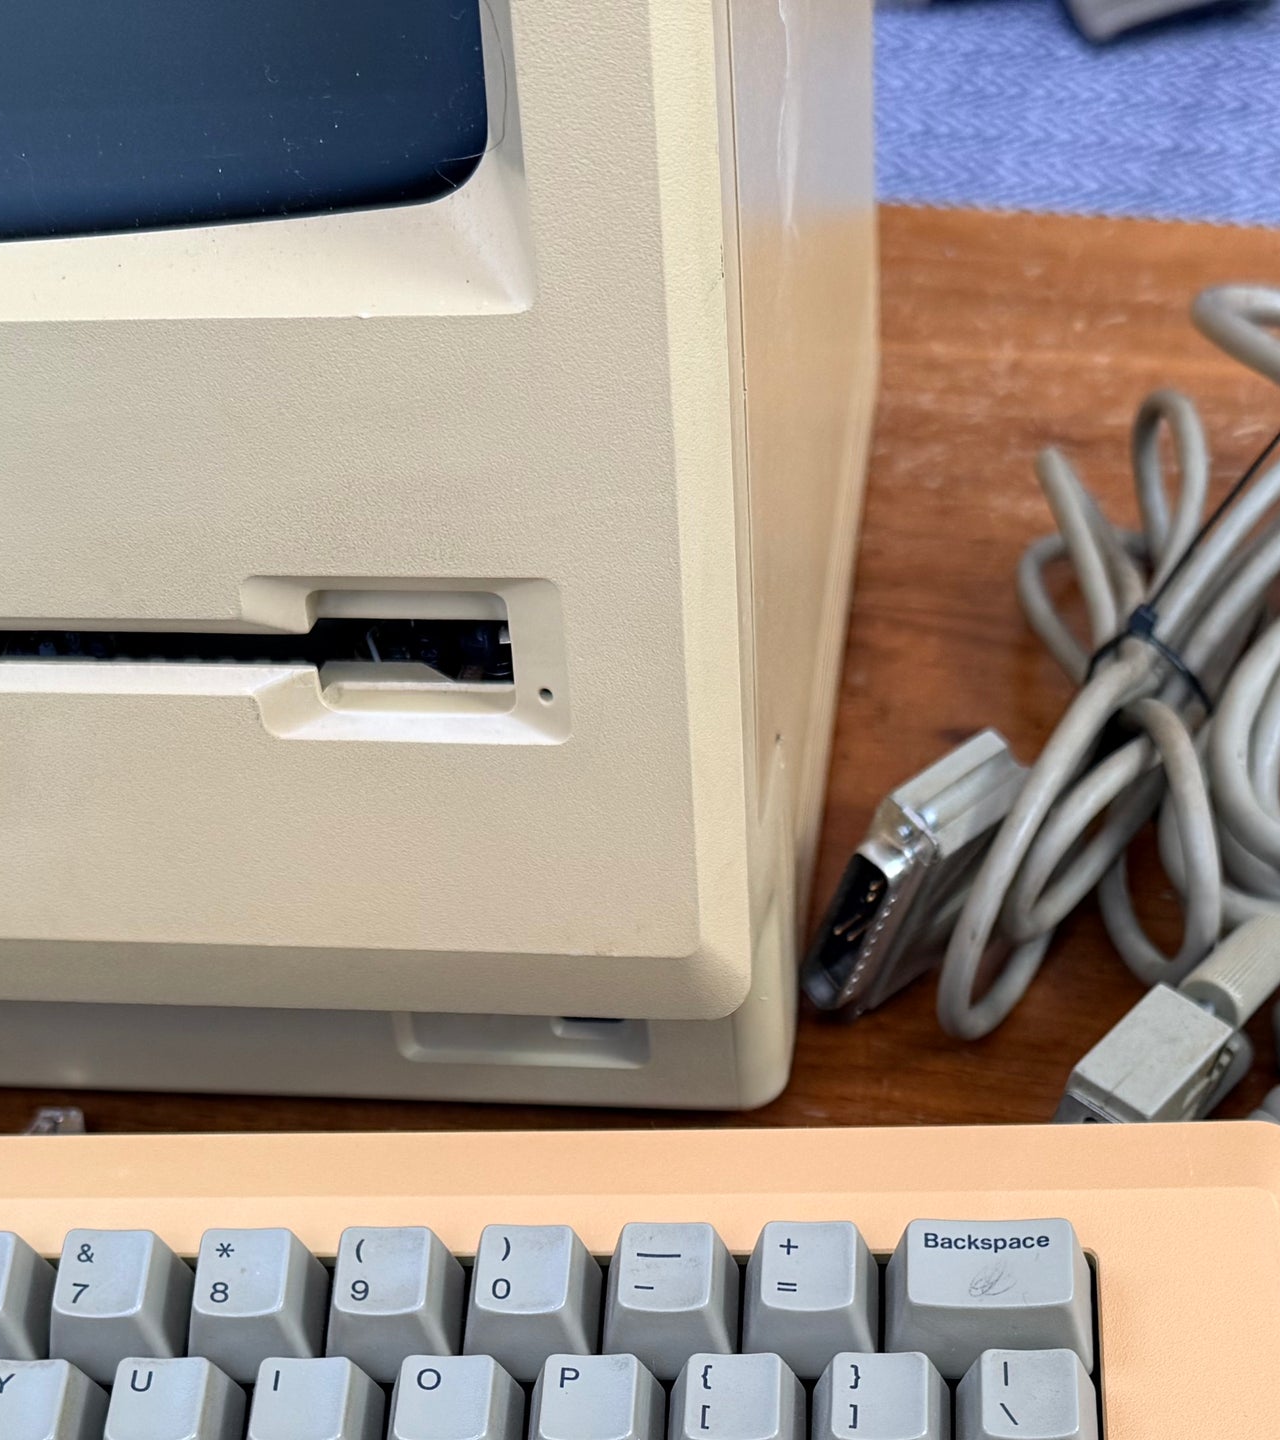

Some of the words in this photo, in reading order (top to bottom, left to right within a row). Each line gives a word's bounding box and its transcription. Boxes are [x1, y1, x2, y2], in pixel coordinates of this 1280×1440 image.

[76, 1242, 95, 1264] &
[354, 1238, 366, 1264] (
[500, 1236, 512, 1262] )
[778, 1237, 800, 1256] +
[923, 1231, 1051, 1254] Backspace
[71, 1282, 91, 1305] 7
[209, 1281, 230, 1304] 8
[349, 1279, 370, 1302] 9
[491, 1277, 512, 1301] 0
[776, 1281, 798, 1293] =
[129, 1369, 154, 1393] U
[272, 1369, 281, 1392] I
[416, 1367, 442, 1391] O
[559, 1366, 581, 1389] P
[700, 1364, 713, 1391] {
[848, 1363, 862, 1390] }
[1002, 1360, 1009, 1387] |
[699, 1404, 711, 1431] [
[847, 1403, 859, 1430] ]
[999, 1402, 1020, 1426] \
